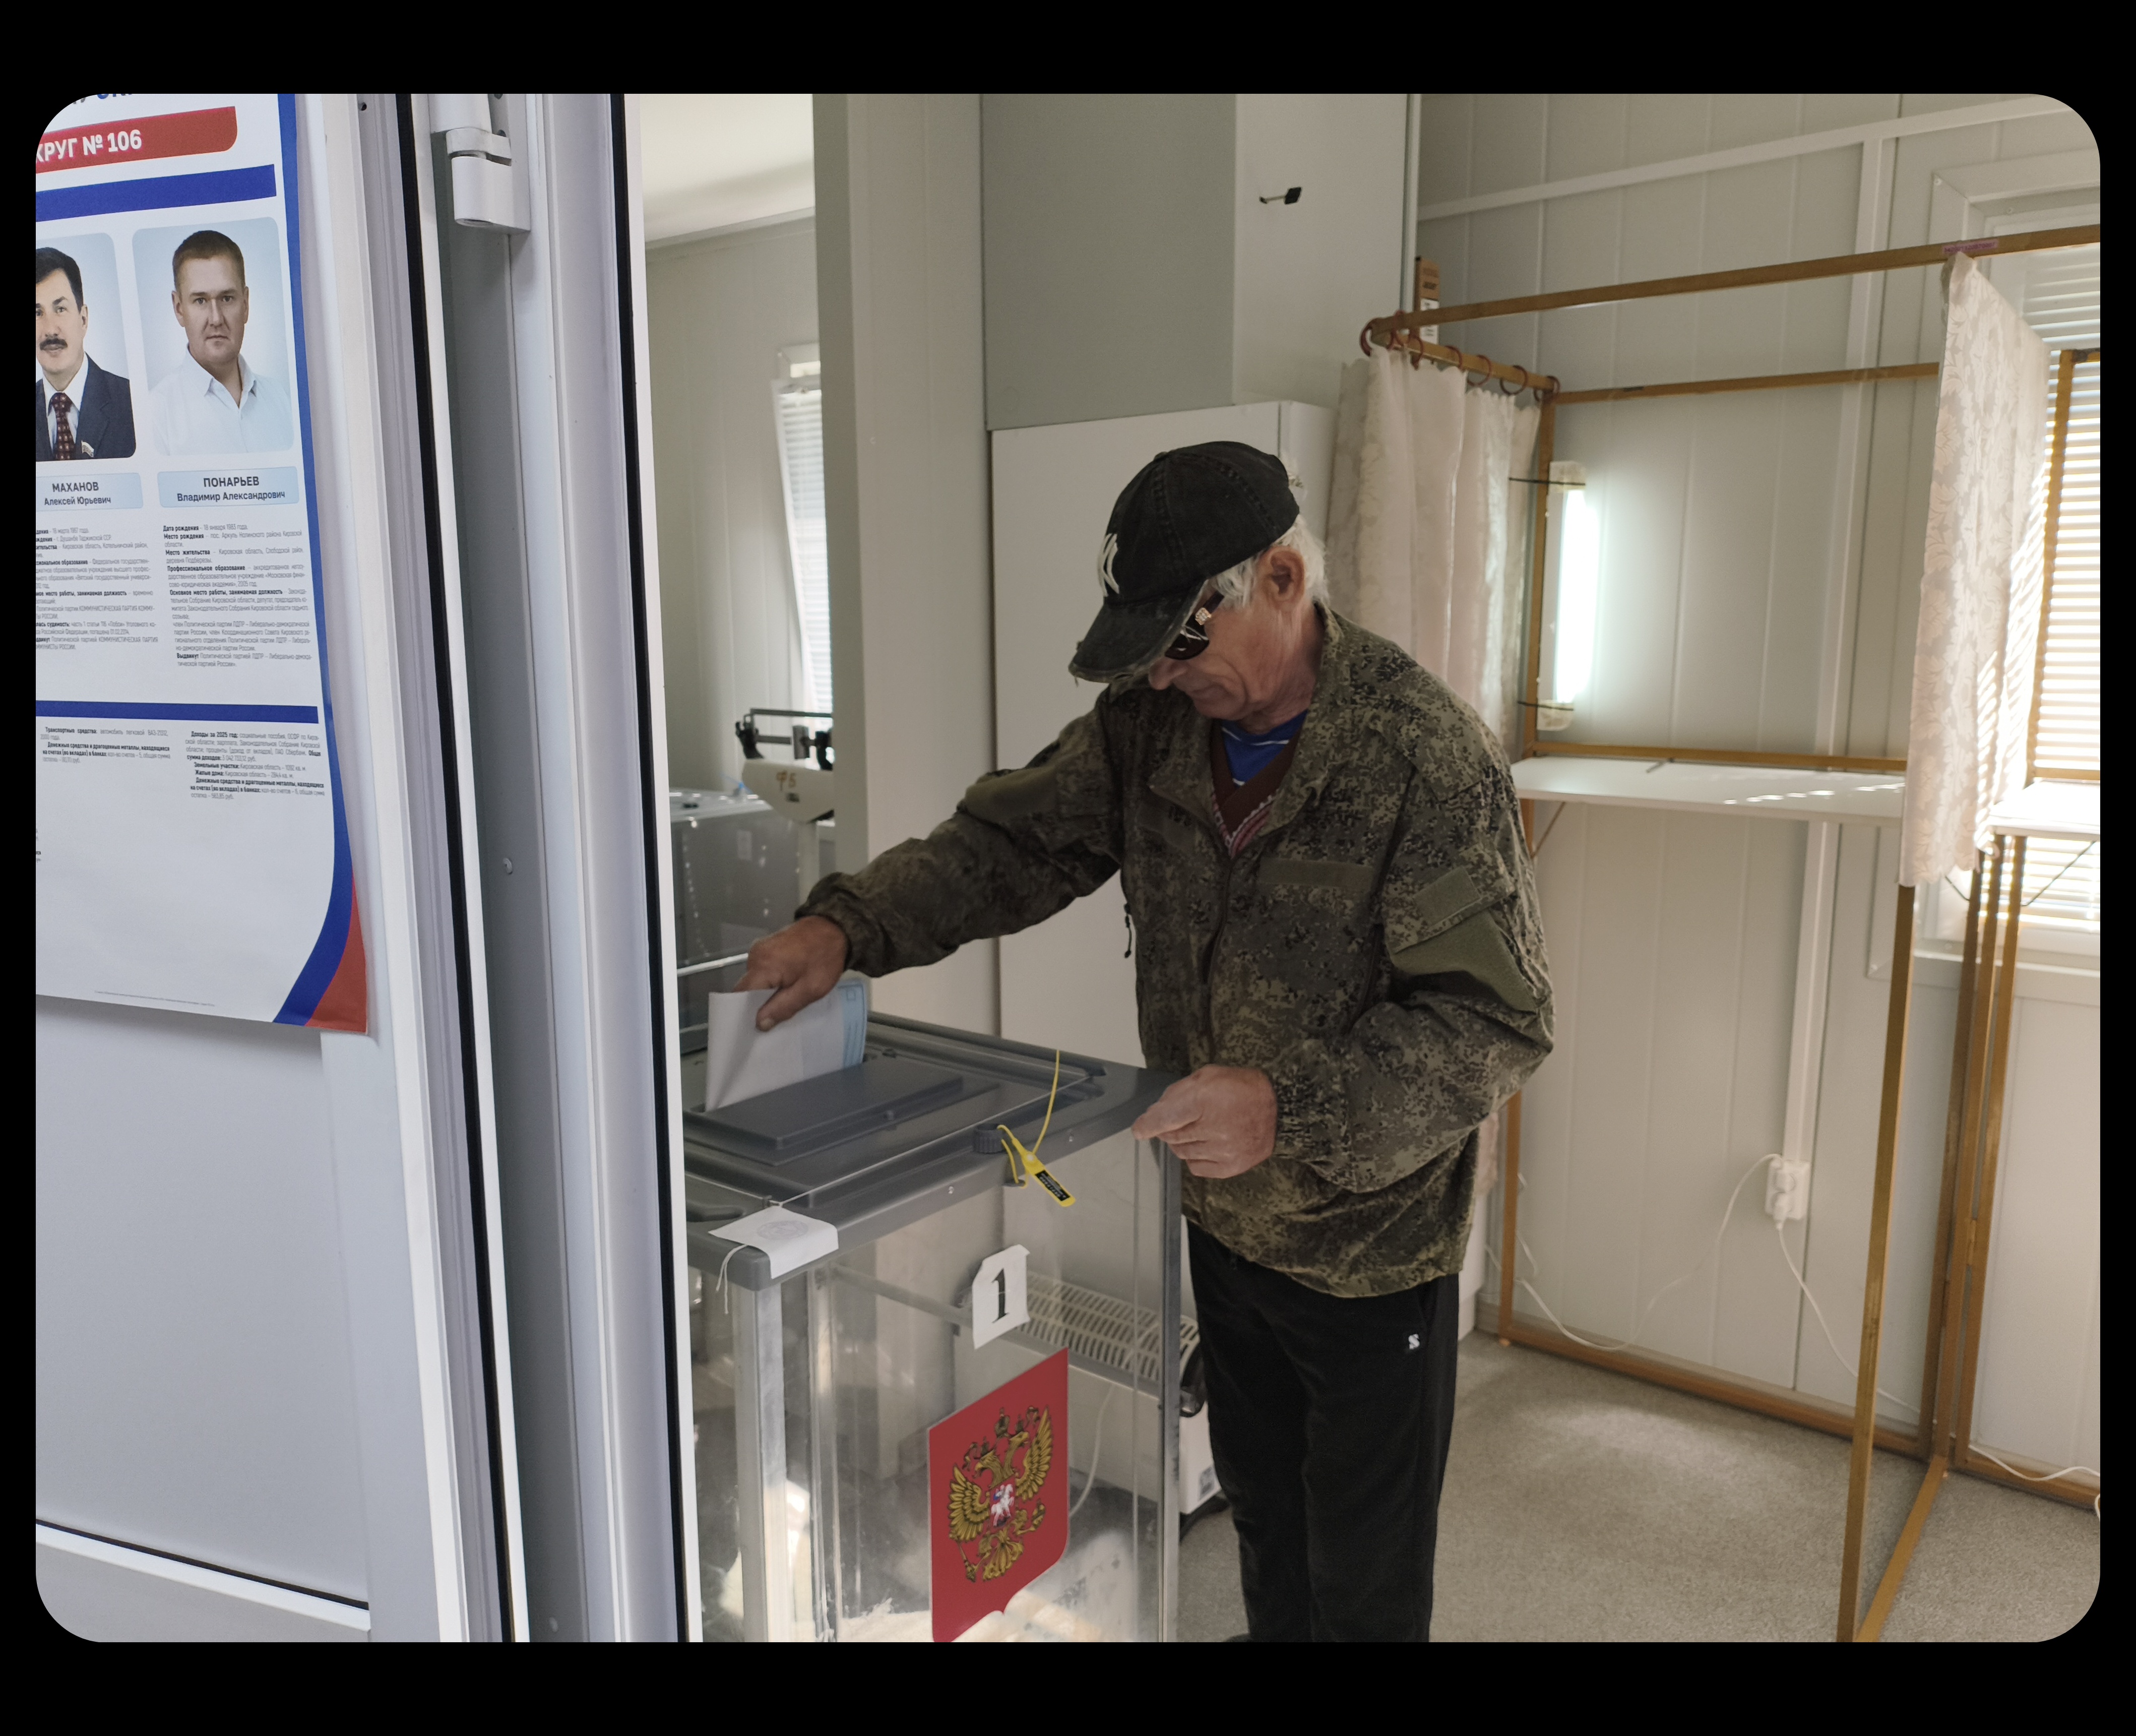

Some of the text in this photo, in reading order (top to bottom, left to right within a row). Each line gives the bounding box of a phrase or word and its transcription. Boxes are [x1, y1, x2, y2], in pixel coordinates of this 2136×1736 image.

[82, 134, 103, 155] №
[107, 129, 142, 152] 106
[52, 482, 99, 492] МАХАНОВ
[204, 476, 259, 487] ПОНАРЬЕВ
[44, 496, 111, 506] Алексей Юрьевич
[177, 491, 285, 502] Владимир Александрович
[991, 1268, 1010, 1324] 1
